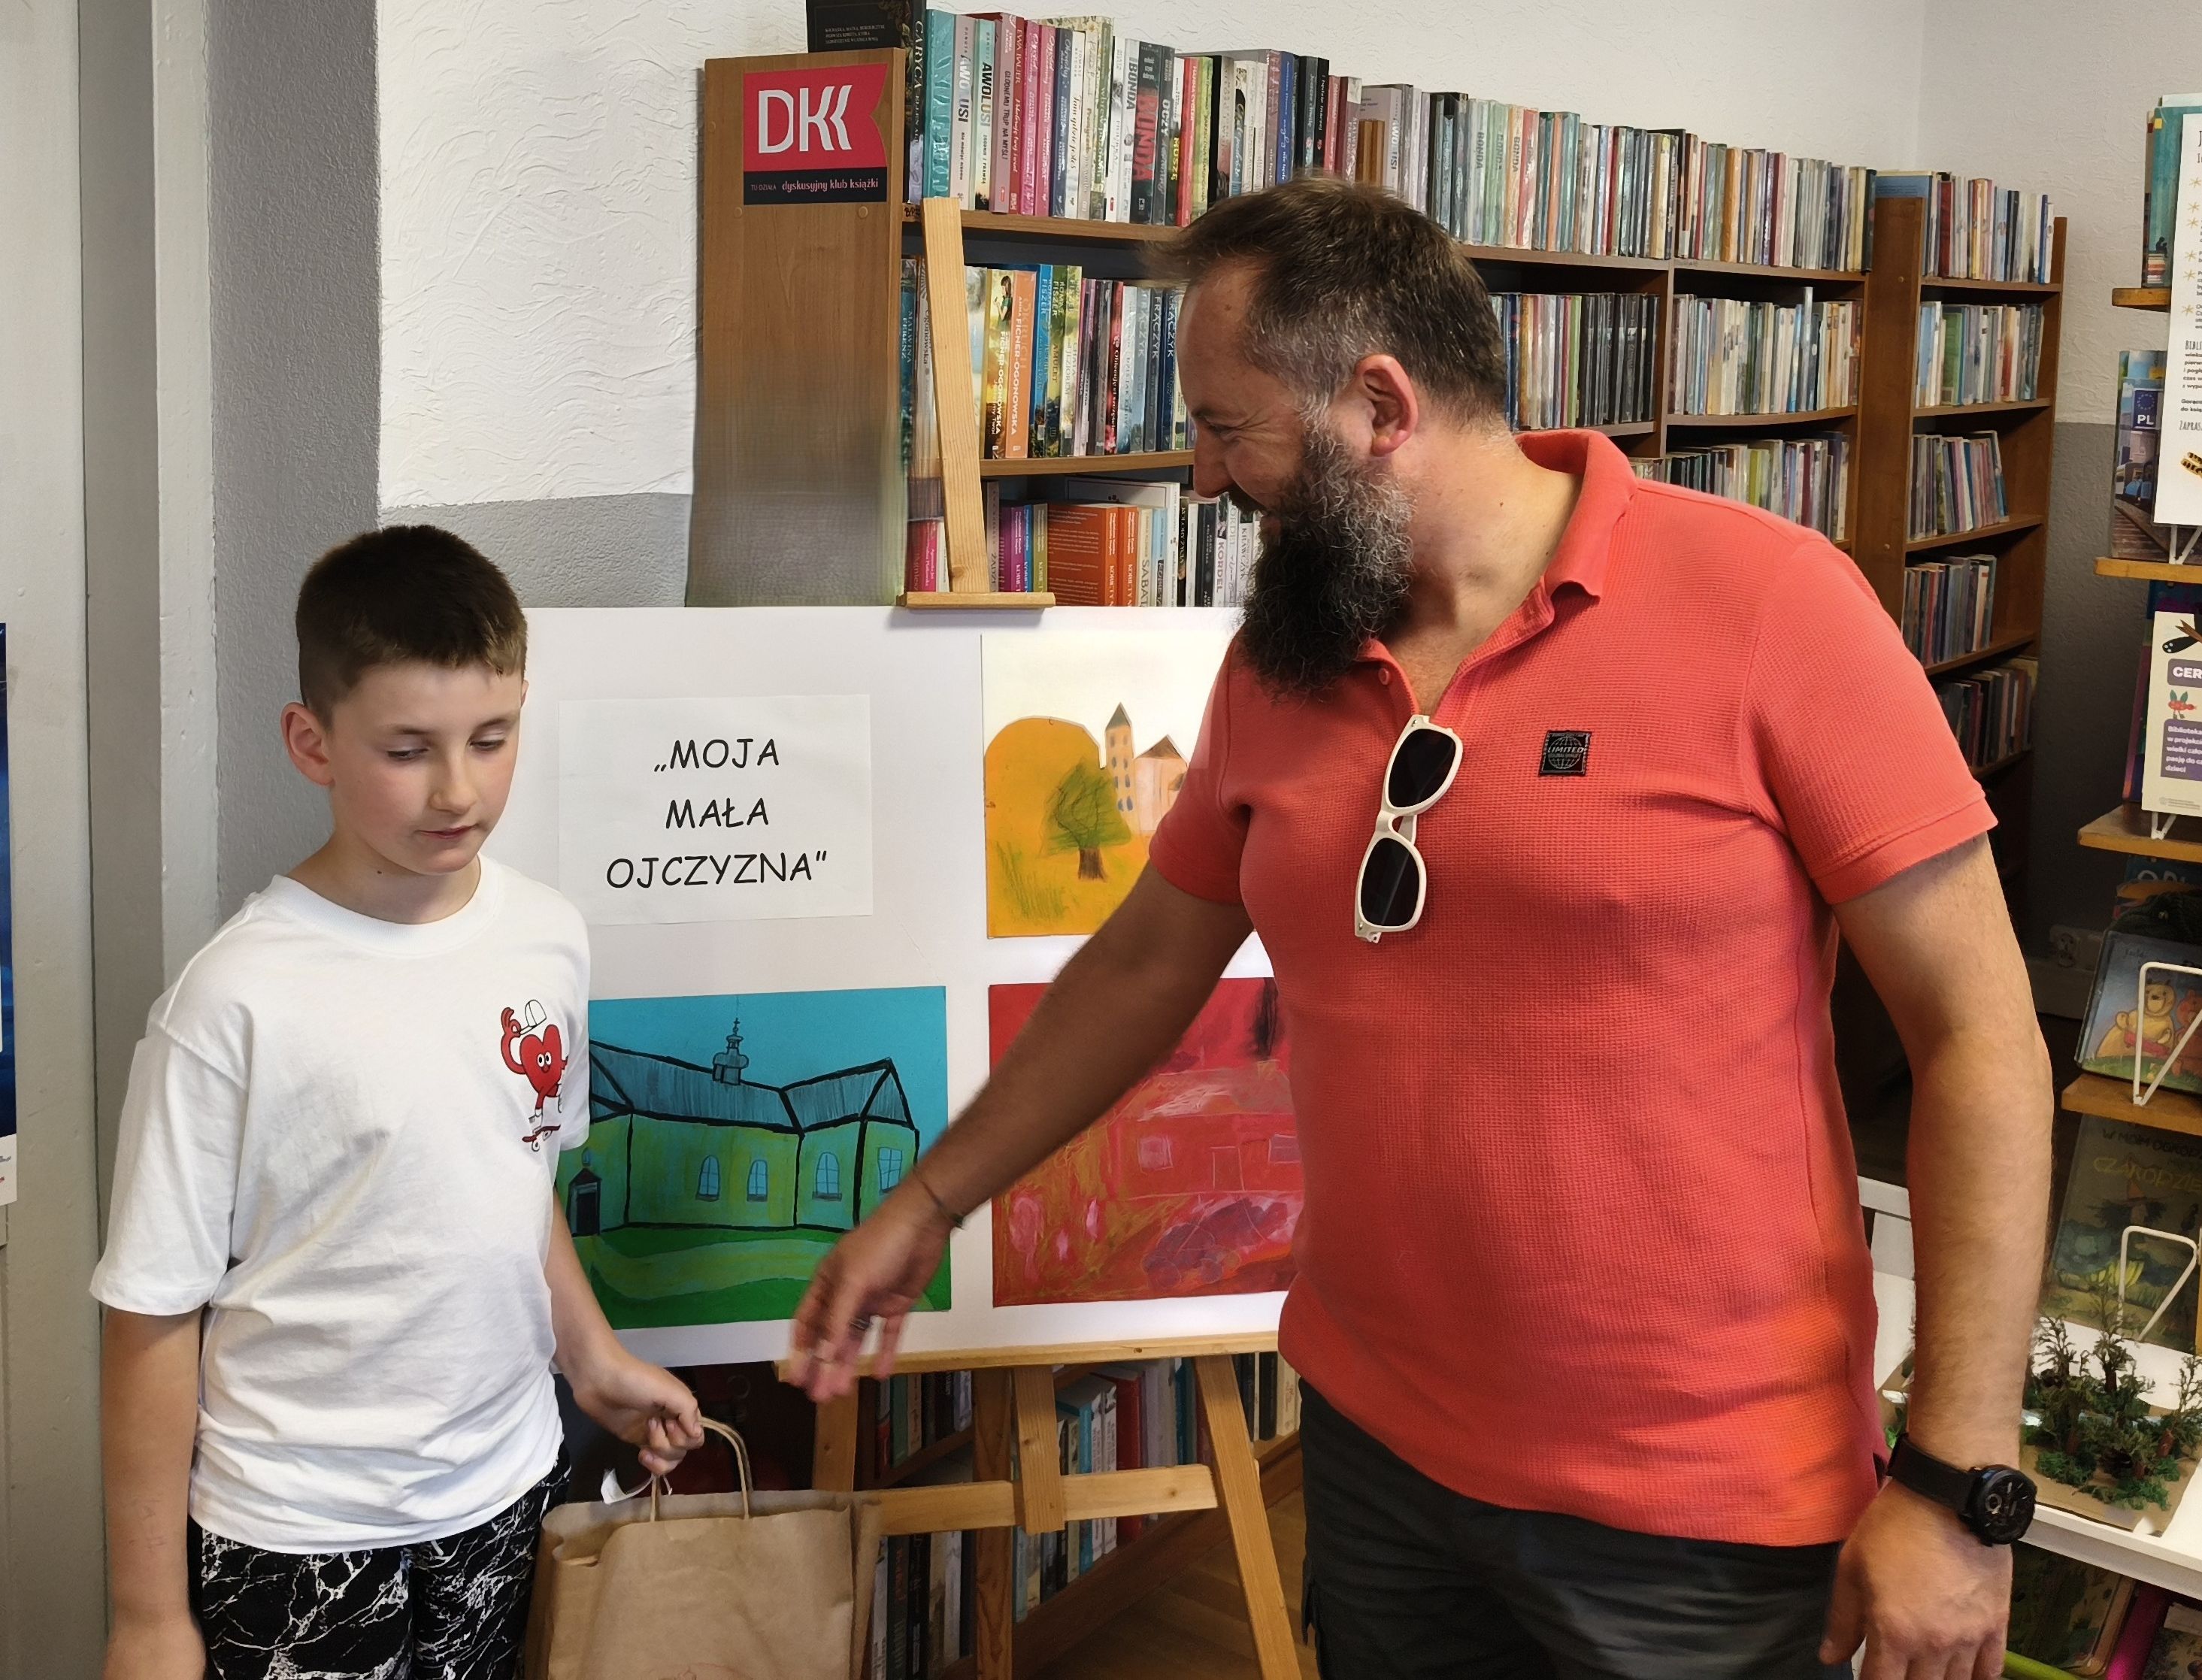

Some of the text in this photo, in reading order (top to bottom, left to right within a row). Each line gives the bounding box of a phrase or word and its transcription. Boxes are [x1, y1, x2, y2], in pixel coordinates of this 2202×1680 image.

[914, 20, 923, 89] CARYCA
[980, 62, 992, 126] AWOLUSI
[1127, 64, 1137, 110] BONDA
[1002, 129, 1008, 138] NA
[1133, 95, 1158, 181] BONDA
[782, 180, 828, 193] dyskusyjny
[829, 178, 848, 189] klub
[850, 178, 879, 191] książki
[1152, 296, 1161, 359] FRĄCZYK
[1011, 318, 1022, 435] FICNER-OGONOWSKA
[2137, 414, 2155, 425] PL
[665, 797, 769, 829] MAŁA
